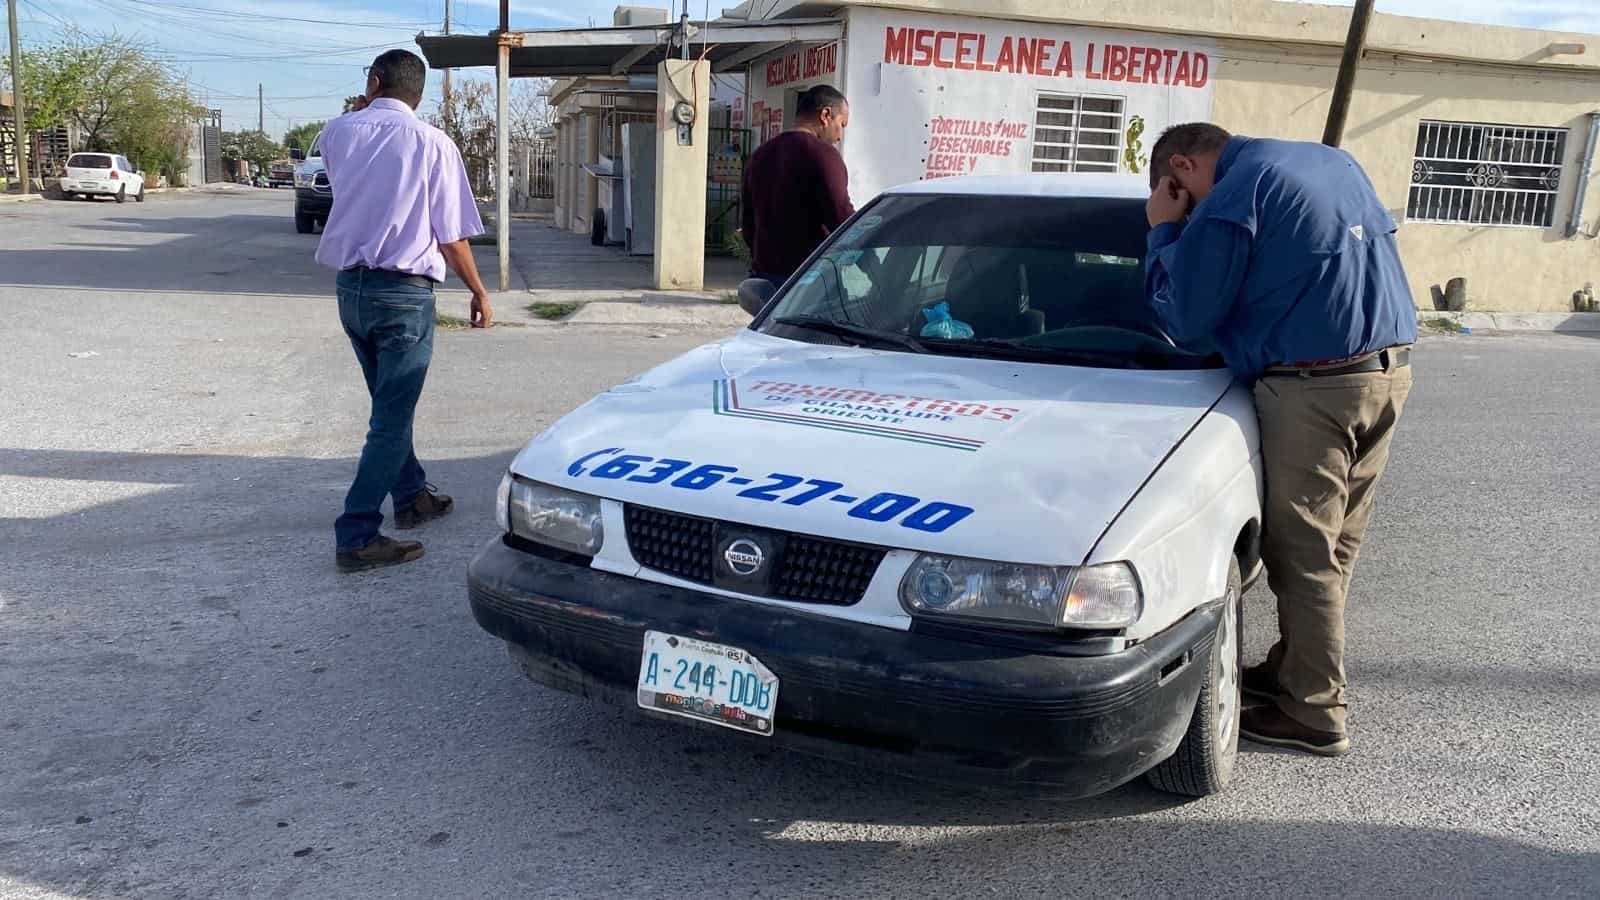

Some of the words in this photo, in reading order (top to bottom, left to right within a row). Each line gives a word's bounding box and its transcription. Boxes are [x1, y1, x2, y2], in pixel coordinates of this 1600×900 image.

[884, 26, 1073, 78] MISCELANEA
[1085, 42, 1209, 89] LIBERTAD
[930, 119, 992, 137] TORTILLAS
[929, 137, 1012, 156] DESECHABLES
[926, 154, 966, 171] LECHE
[748, 380, 1020, 421] TAXIMETROS
[764, 394, 795, 402] DE
[803, 399, 954, 422] GUADALUPE
[802, 406, 904, 424] ORIENTE
[589, 454, 975, 533] 636-27-00
[727, 552, 760, 565] NISSAN
[645, 652, 772, 710] A-244-DDB
